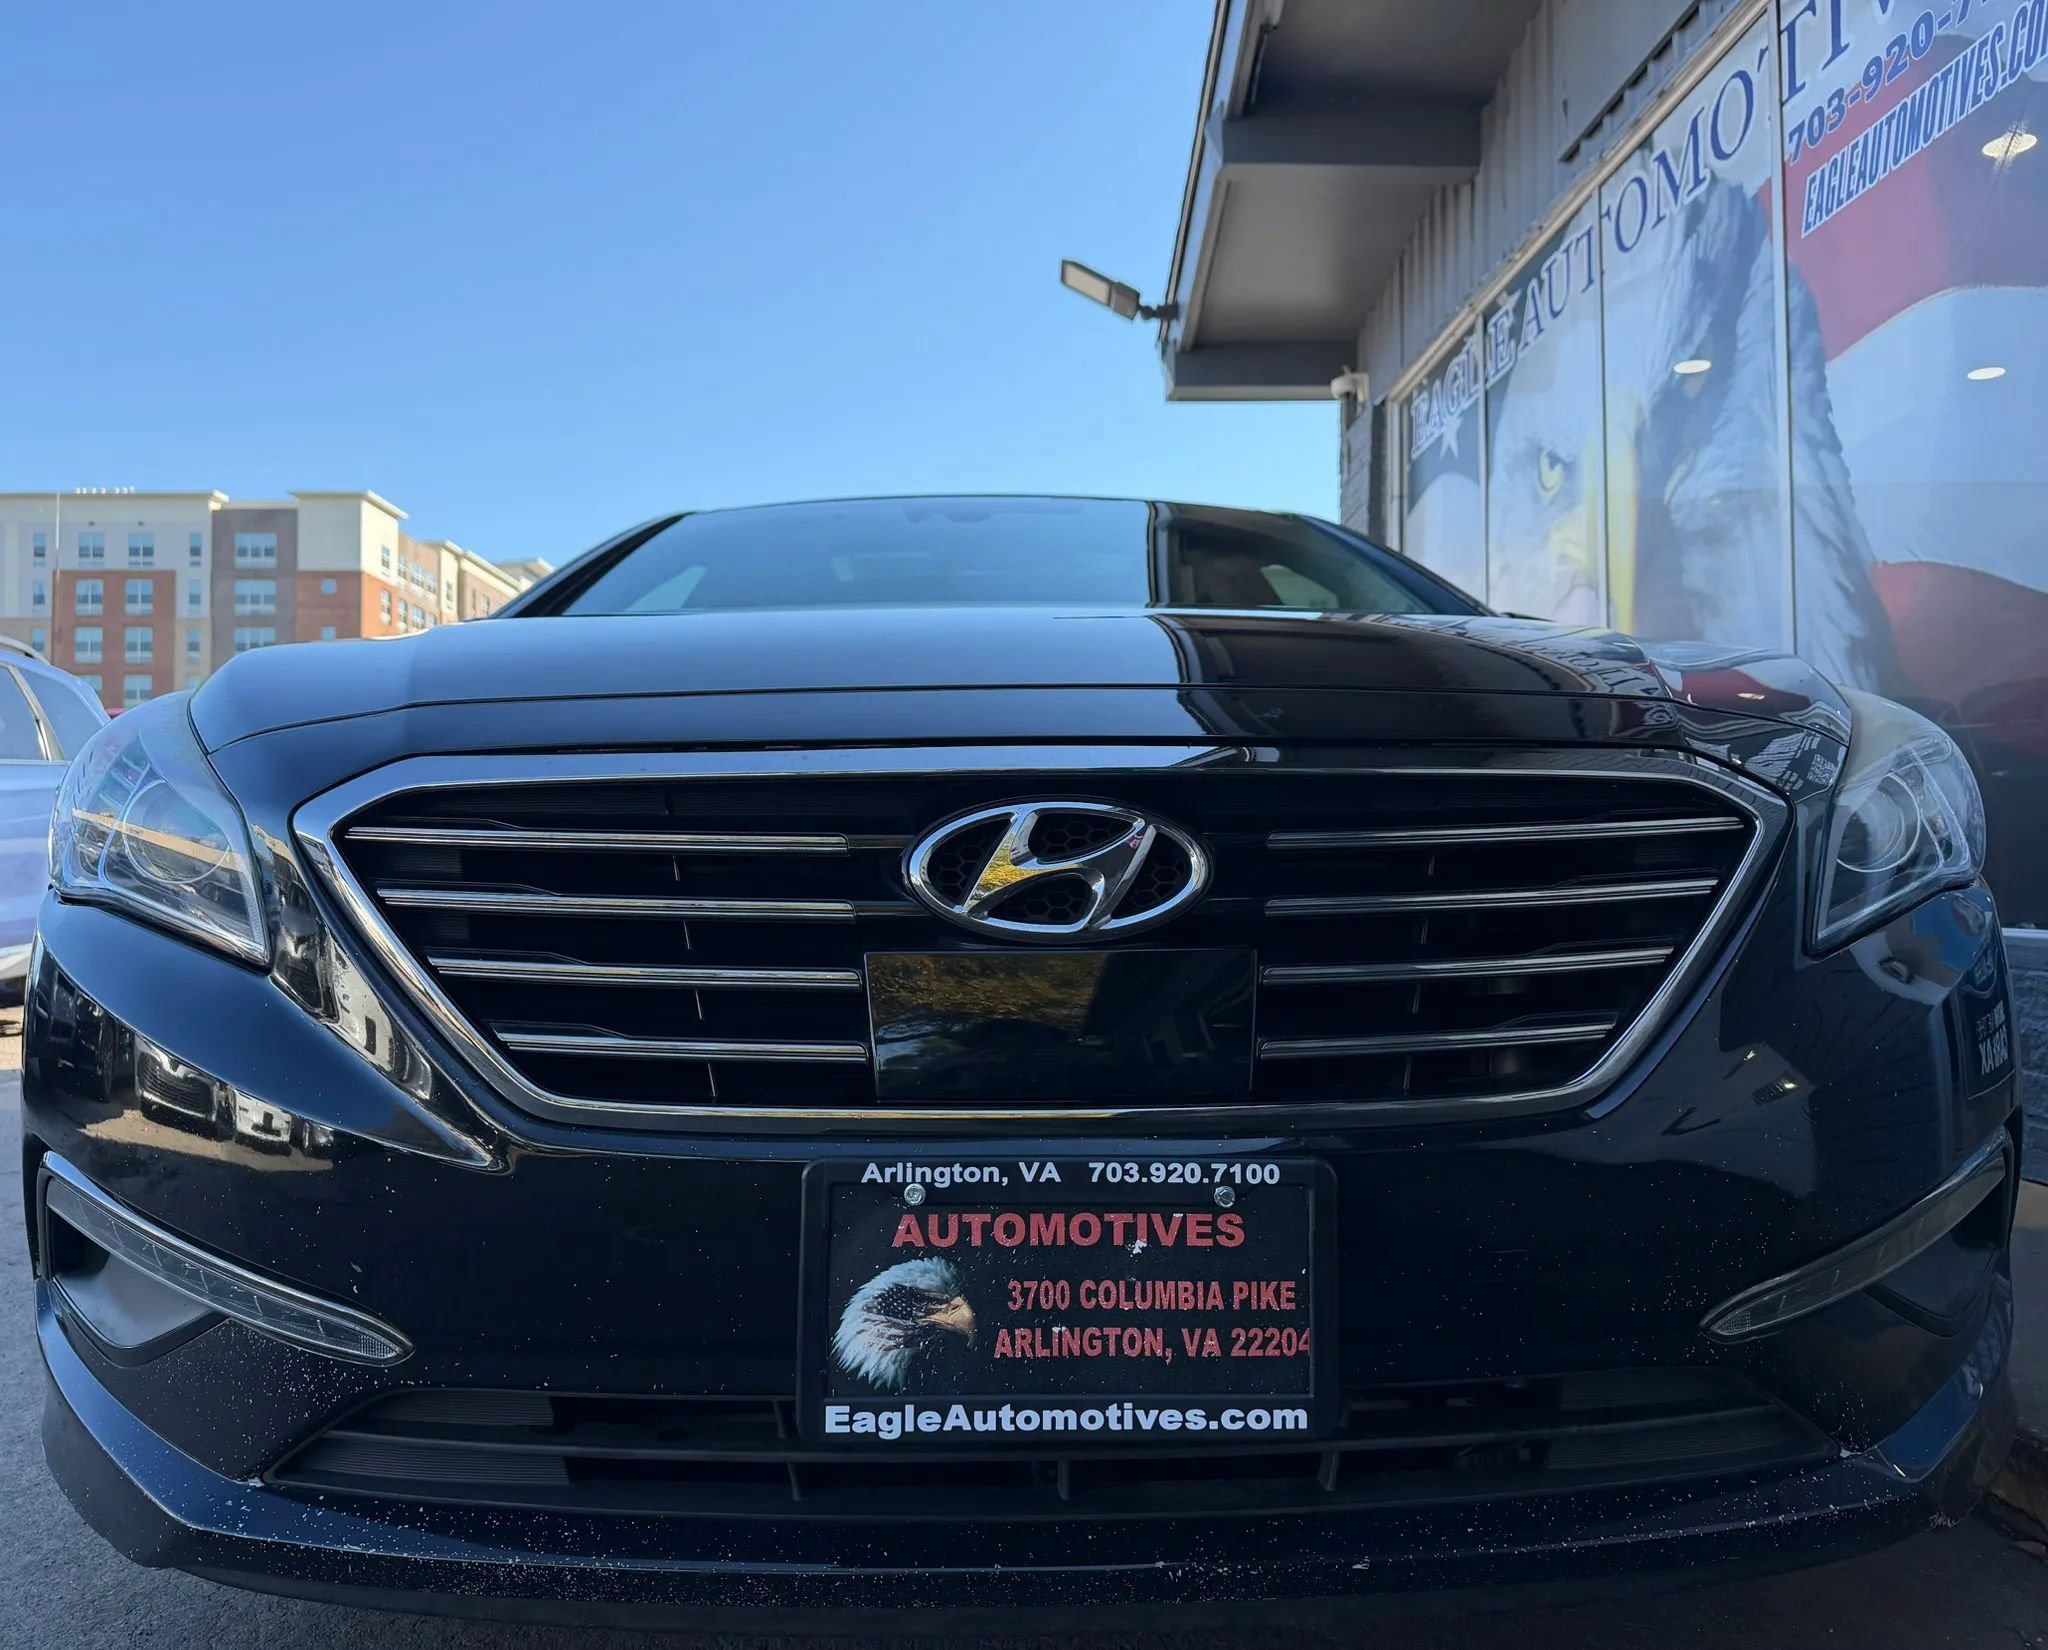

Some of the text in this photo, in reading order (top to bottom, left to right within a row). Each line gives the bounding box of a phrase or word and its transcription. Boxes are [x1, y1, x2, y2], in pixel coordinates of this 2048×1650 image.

[1410, 302, 1517, 460] EAGLE
[861, 1162, 1281, 1188] Arlington, VA 703.920.7100
[891, 1213, 1246, 1248] AUTOMOTIVES
[1007, 1280, 1297, 1311] 3700 COLUMBIA PIKE
[994, 1327, 1312, 1364] ARLINGTON, VA 22204
[824, 1402, 1309, 1440] EagleAutomotives.com
